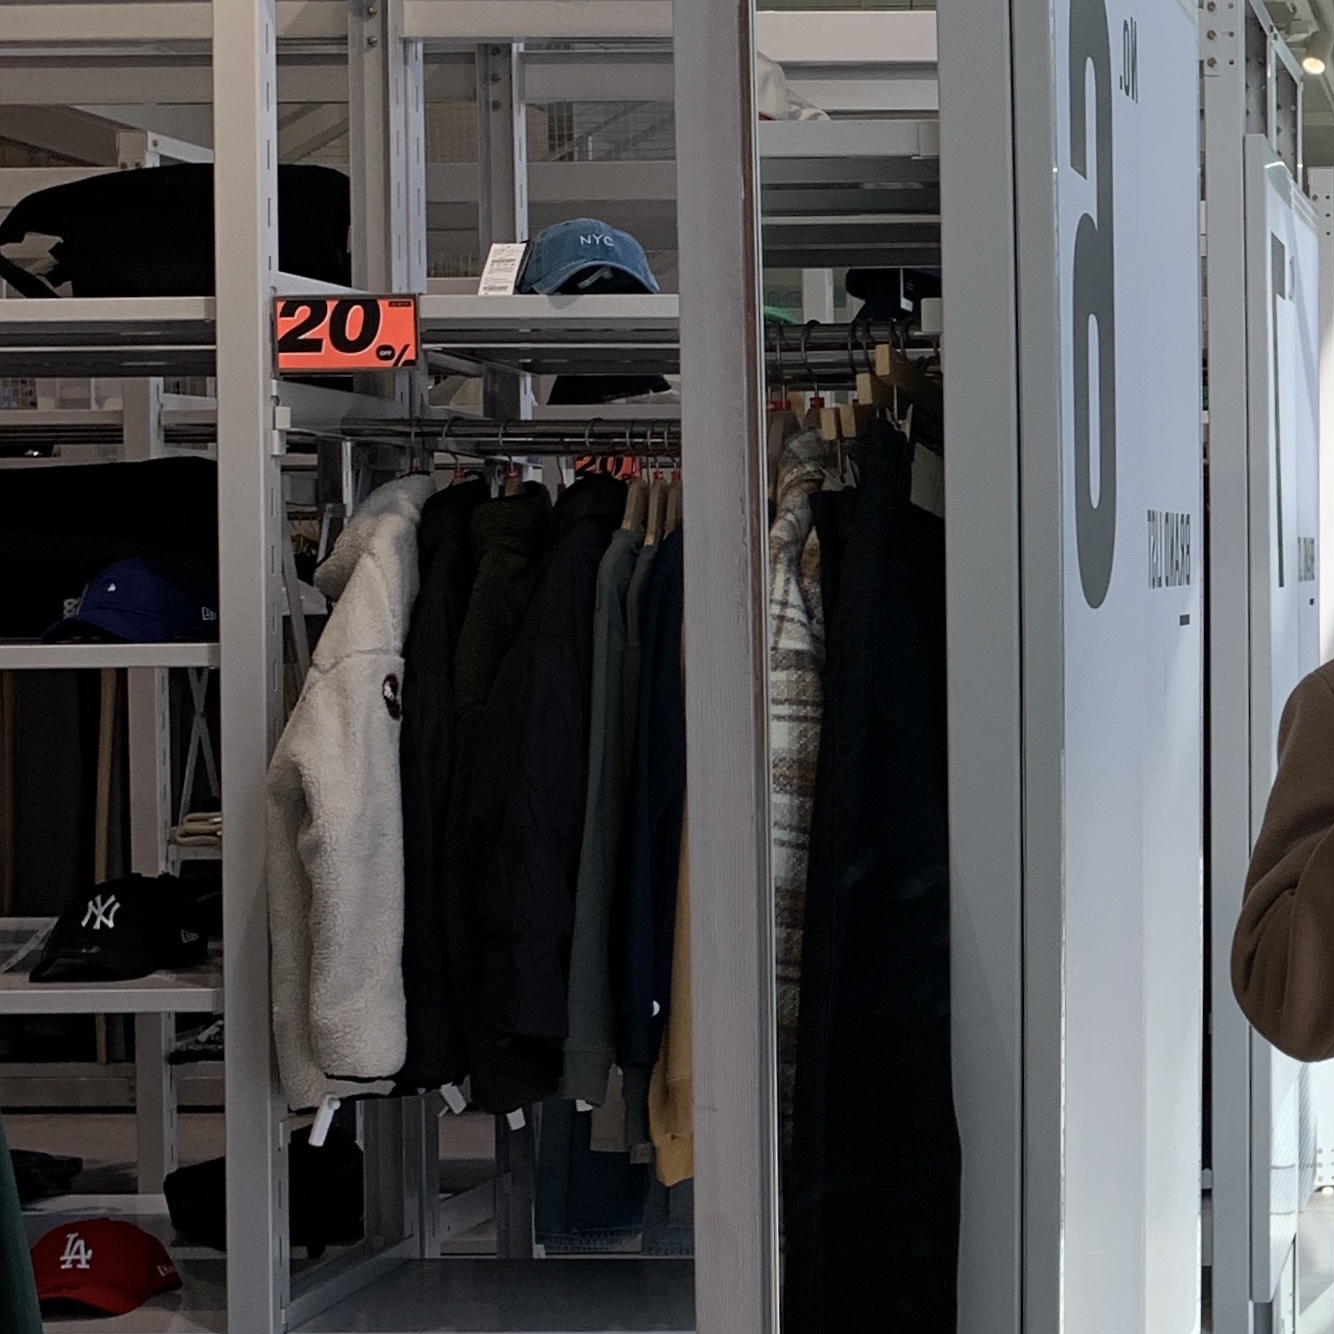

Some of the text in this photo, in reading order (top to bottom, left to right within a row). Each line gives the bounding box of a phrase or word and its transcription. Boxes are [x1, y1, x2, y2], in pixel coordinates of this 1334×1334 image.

[580, 234, 615, 247] NYC
[81, 894, 121, 930] NY
[60, 1232, 93, 1270] LA
